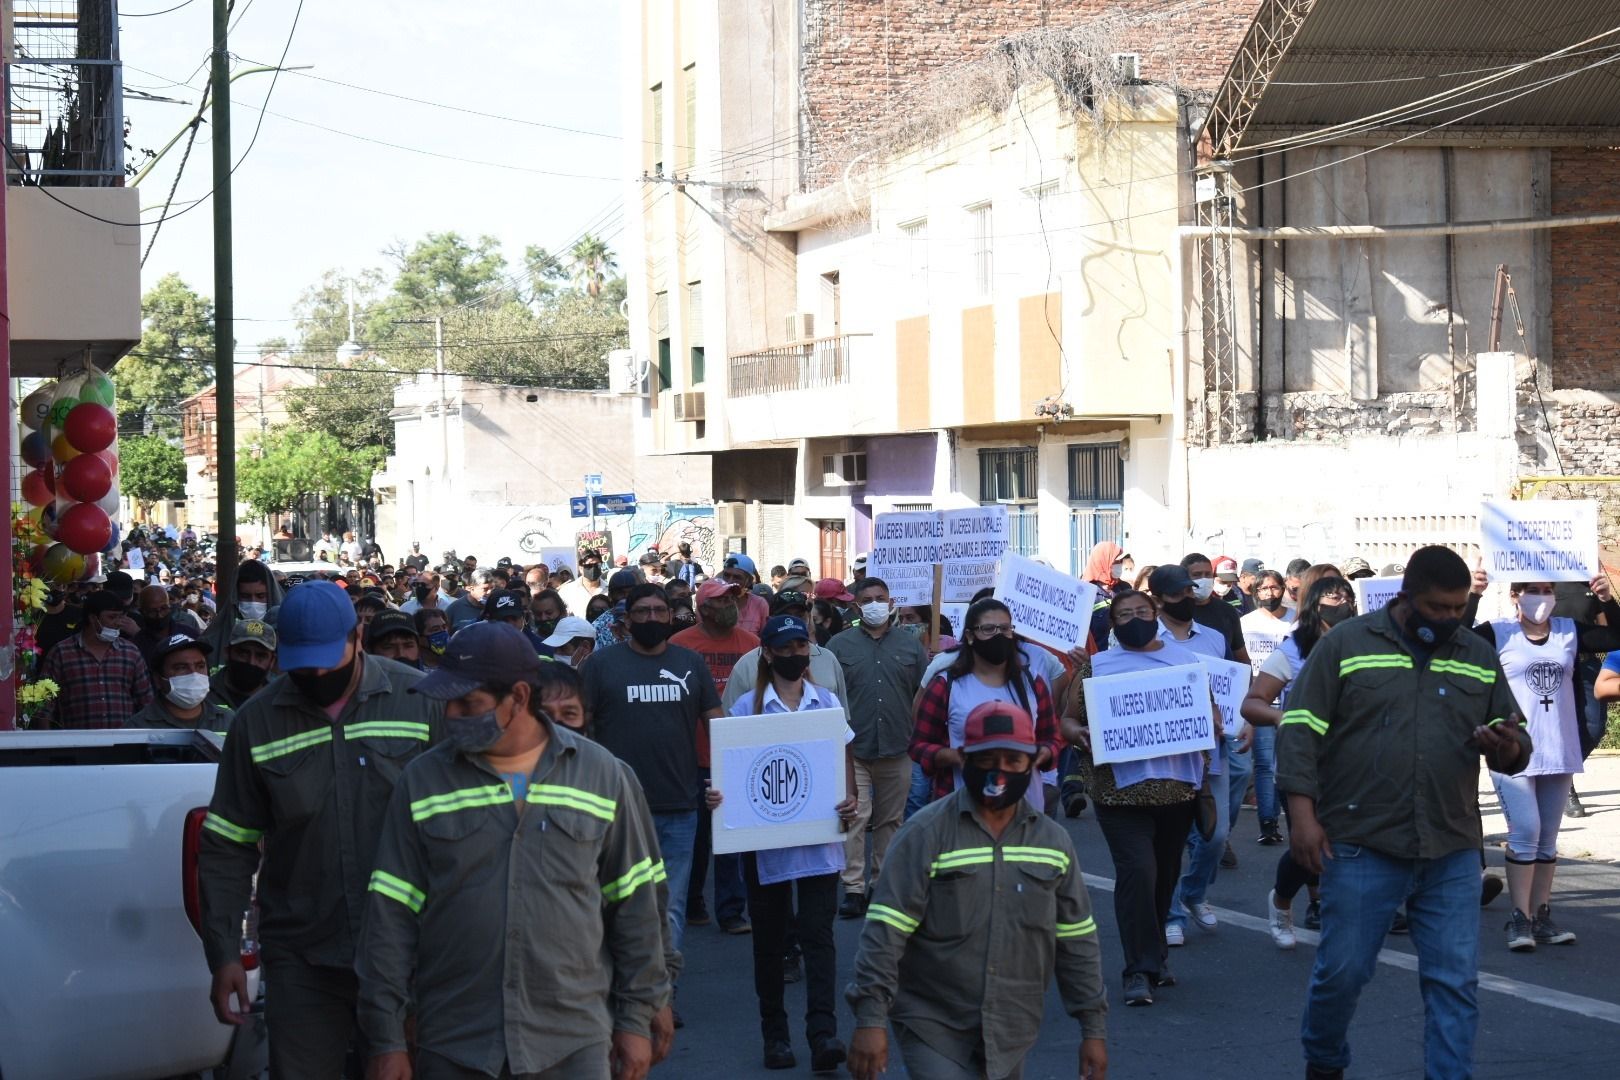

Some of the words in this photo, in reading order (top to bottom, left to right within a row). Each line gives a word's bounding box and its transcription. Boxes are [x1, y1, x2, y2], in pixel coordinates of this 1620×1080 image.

[874, 522, 903, 540] MUJERES
[905, 521, 944, 538] MUNICIPALES
[950, 518, 971, 535] MUJERES
[972, 517, 1002, 534] MUNICIPALES
[1507, 520, 1516, 540] EL
[1518, 520, 1560, 540] DECRETAZO
[1563, 520, 1573, 540] ES
[874, 548, 886, 564] POR
[888, 548, 896, 564] UN
[898, 546, 922, 563] SUELDO
[924, 545, 943, 562] DIGNO
[974, 541, 980, 557] EL
[1493, 550, 1532, 571] VIOLENCIA
[1534, 550, 1587, 571] INSTITUCIONAL
[1014, 572, 1042, 599] MUJERES
[1040, 582, 1076, 613] MUNICIPALES
[1038, 611, 1046, 632] EL
[1045, 614, 1079, 643] DECRETAZO
[1250, 640, 1273, 653] MUJERES
[627, 685, 680, 702] PUMA
[1109, 692, 1145, 718] MUJERES
[1145, 685, 1194, 712] MUNICIPALES
[1103, 724, 1155, 752] RECHAZAMOS
[1154, 723, 1165, 745] EL
[1166, 716, 1209, 743] DECRETAZO
[761, 758, 798, 804] SOEM
